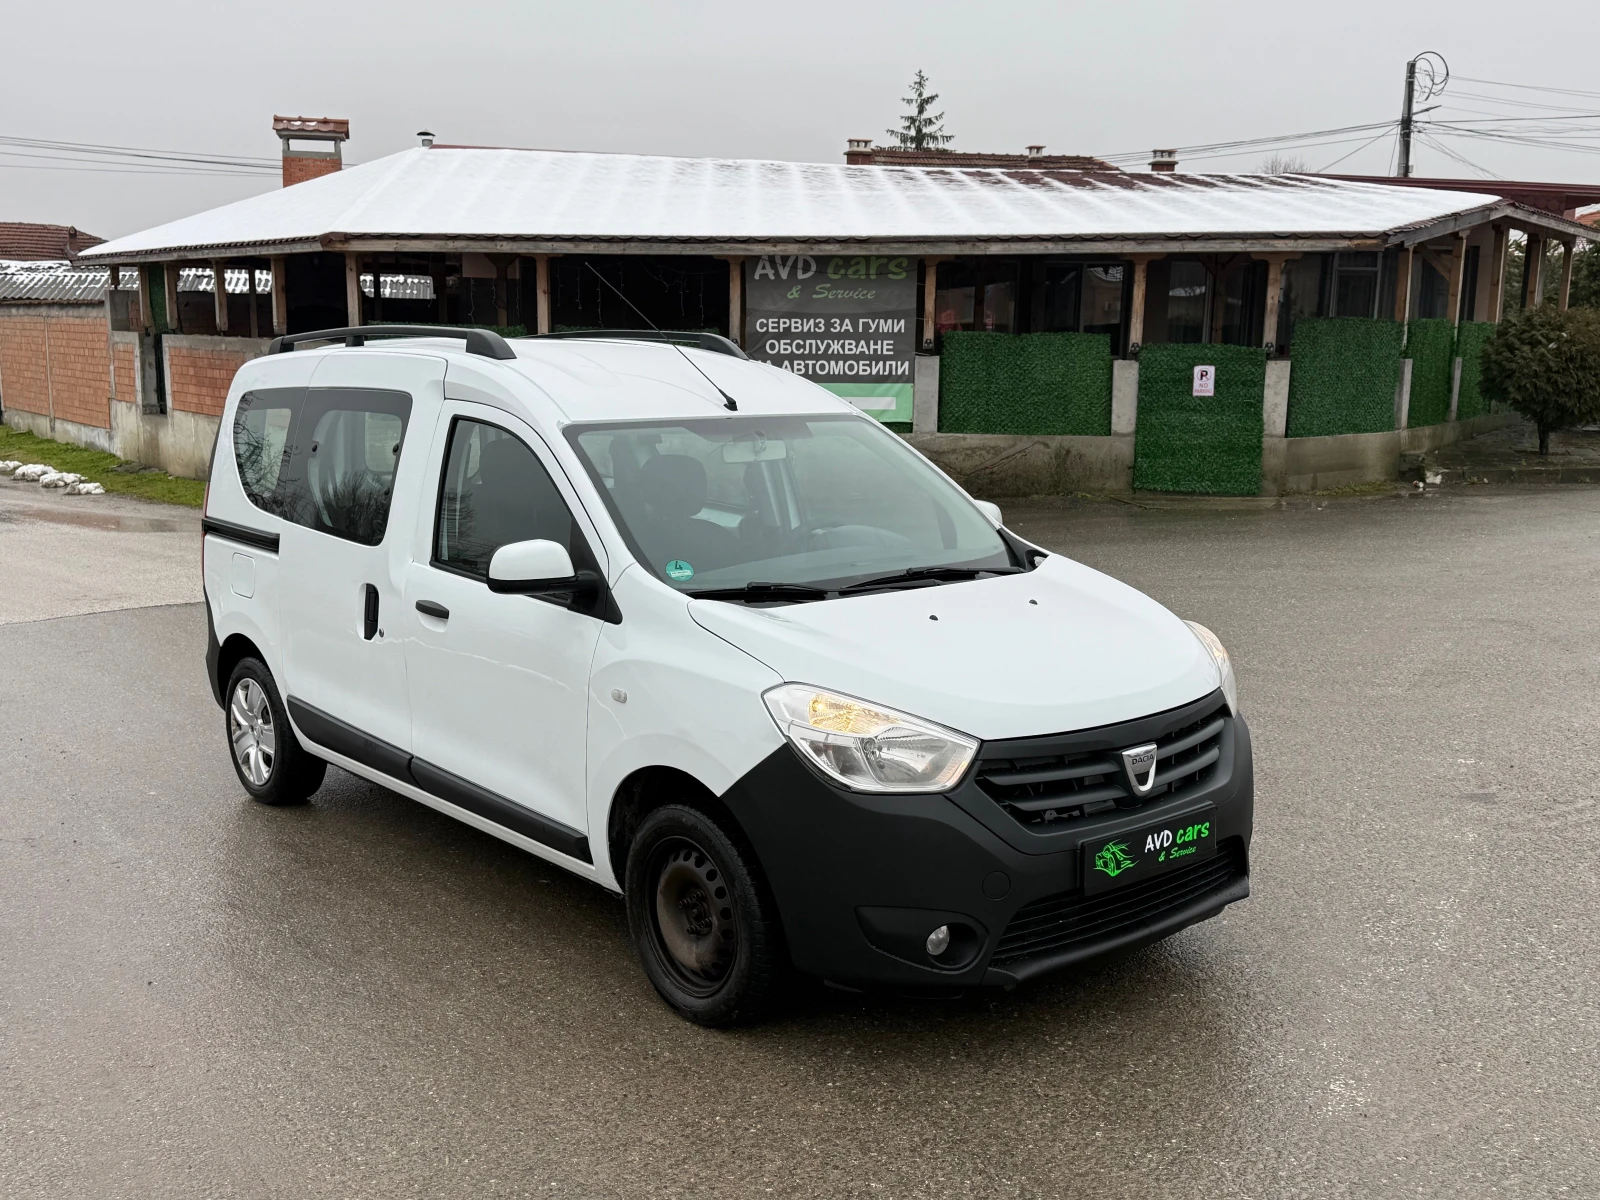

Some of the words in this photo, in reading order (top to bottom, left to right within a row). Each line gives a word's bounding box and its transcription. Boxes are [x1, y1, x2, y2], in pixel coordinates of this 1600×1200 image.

[754, 254, 816, 280] AVD
[827, 256, 908, 280] cars
[787, 285, 802, 299] &
[812, 283, 876, 300] Service
[755, 318, 826, 334] СЕРВИЗ
[830, 318, 854, 333] ЗА
[858, 318, 906, 334] ГУМИ
[765, 339, 894, 355] ОБСЛУЖВАНЕ
[781, 360, 910, 376] АВТОМОБИЛИ
[675, 561, 683, 570] 4
[1131, 754, 1154, 765] DACIA
[1144, 829, 1173, 853] AVD
[1176, 821, 1210, 844] cars
[1158, 851, 1166, 862] &
[1169, 846, 1197, 859] Service
